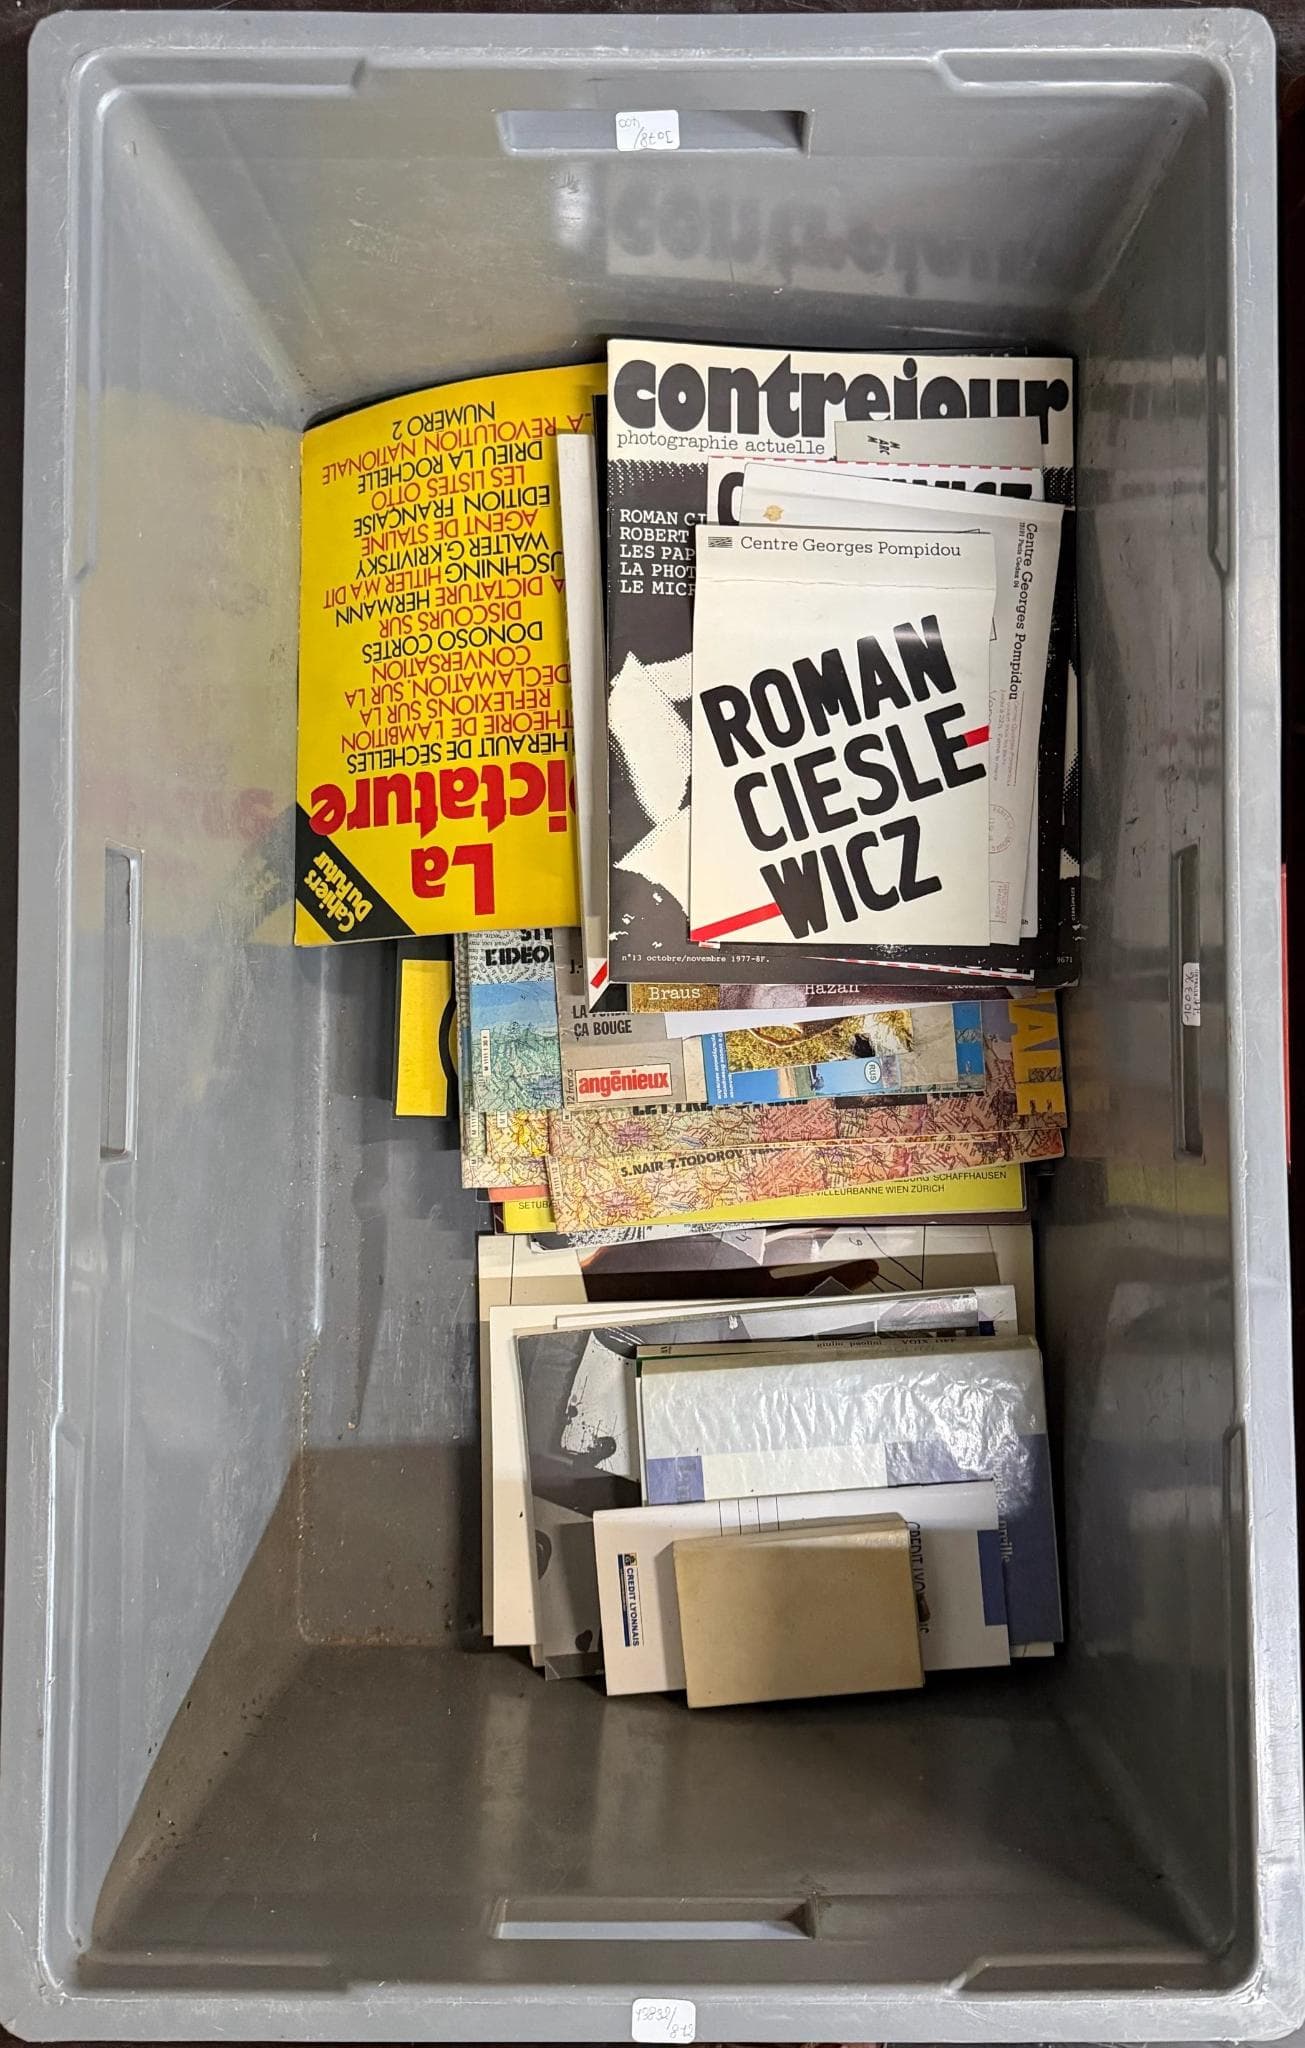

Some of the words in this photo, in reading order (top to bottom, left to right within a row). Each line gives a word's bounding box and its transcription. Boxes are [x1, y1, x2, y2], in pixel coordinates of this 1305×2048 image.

[393, 421, 402, 441] 2
[617, 430, 738, 455] photographie
[745, 436, 825, 455] actuelle
[322, 438, 416, 485] NATIONALE
[450, 450, 473, 468] LA
[483, 440, 542, 465] DRIEU
[358, 453, 443, 494] ROCHELLE
[428, 471, 485, 498] LISTES
[493, 465, 525, 486] LES
[372, 481, 421, 510] OTTO
[353, 500, 454, 538] FRANÇAISE
[467, 509, 538, 535] AGENT
[620, 509, 678, 525] ROMAN
[361, 524, 428, 557] STALINE
[435, 521, 458, 540] DE
[620, 527, 689, 543] ROBERT
[470, 531, 549, 556] WALTER
[620, 544, 655, 558] LES
[740, 535, 799, 552] Centre
[802, 537, 873, 558] Georges
[877, 540, 961, 559] Pompidou
[1023, 523, 1038, 567] Centre
[620, 562, 644, 575] LA
[386, 569, 441, 595] HITLER
[435, 576, 543, 601] DICTATURE
[620, 579, 643, 593] LE
[323, 586, 346, 609] DIT
[336, 590, 430, 627] HERMANN
[1016, 571, 1033, 629] Georges
[379, 614, 412, 638] SUR
[418, 601, 521, 631] DISCOURS
[437, 621, 543, 650] DONOSO
[372, 645, 531, 683] CONVERSATION
[1009, 634, 1026, 700] Pompidou
[345, 689, 365, 708] LA
[372, 682, 402, 704] SUR
[699, 613, 957, 767] ROMAN
[359, 707, 381, 728] LA
[387, 700, 422, 724] SUR
[341, 720, 443, 753] L'AMBITION
[451, 717, 477, 738] DE
[448, 739, 471, 760] DE
[733, 702, 987, 852] CIESLE
[309, 759, 575, 839] ictature
[410, 842, 495, 916] La
[760, 816, 942, 939] WICZ
[303, 869, 355, 933] Cahiers
[621, 953, 642, 962] n°13
[646, 954, 726, 963] octobre/novembre
[648, 986, 701, 1000] Braus
[804, 984, 860, 995] Hazan
[573, 1005, 588, 1019] LA
[574, 1022, 589, 1041] ÇA
[593, 1020, 632, 1036] BOUGE
[868, 1064, 877, 1081] RUS
[621, 1162, 664, 1177] S.NAIR
[933, 1172, 1006, 1181] SCHAFFHAUSEN
[885, 1186, 909, 1194] WIEN
[627, 1568, 636, 1600] CREDIT
[629, 1602, 639, 1647] LYONNAIS
